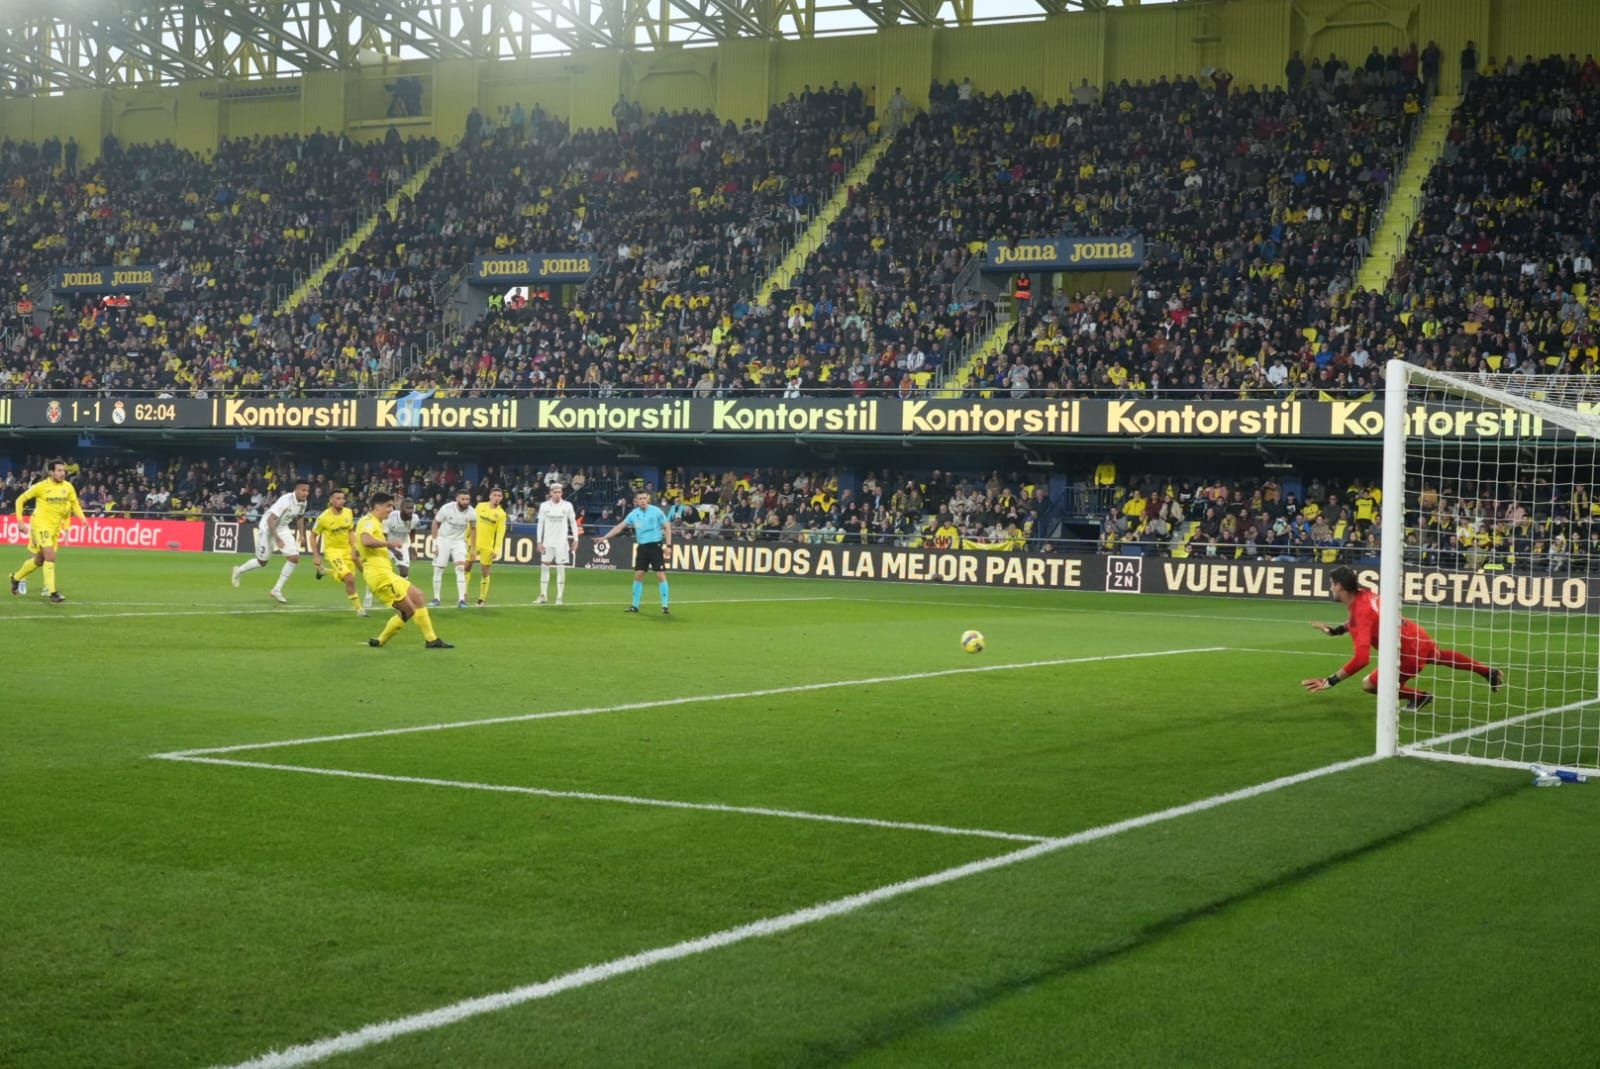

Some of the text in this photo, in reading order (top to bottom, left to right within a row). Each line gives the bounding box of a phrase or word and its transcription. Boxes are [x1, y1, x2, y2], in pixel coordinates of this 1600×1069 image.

[135, 404, 176, 420] 62:04
[225, 399, 357, 427] Kontorstil
[376, 399, 518, 428] Kontorstil
[538, 400, 690, 429] Kontorstil
[713, 400, 877, 430] Kontorstil
[902, 400, 1080, 432] Kontorstil
[1107, 401, 1301, 434] Kontorstil
[632, 543, 1082, 587] NVENIDOS A LA MEJOR PARTE
[1163, 563, 1587, 609] VUELVE EL SECTÁCULO
